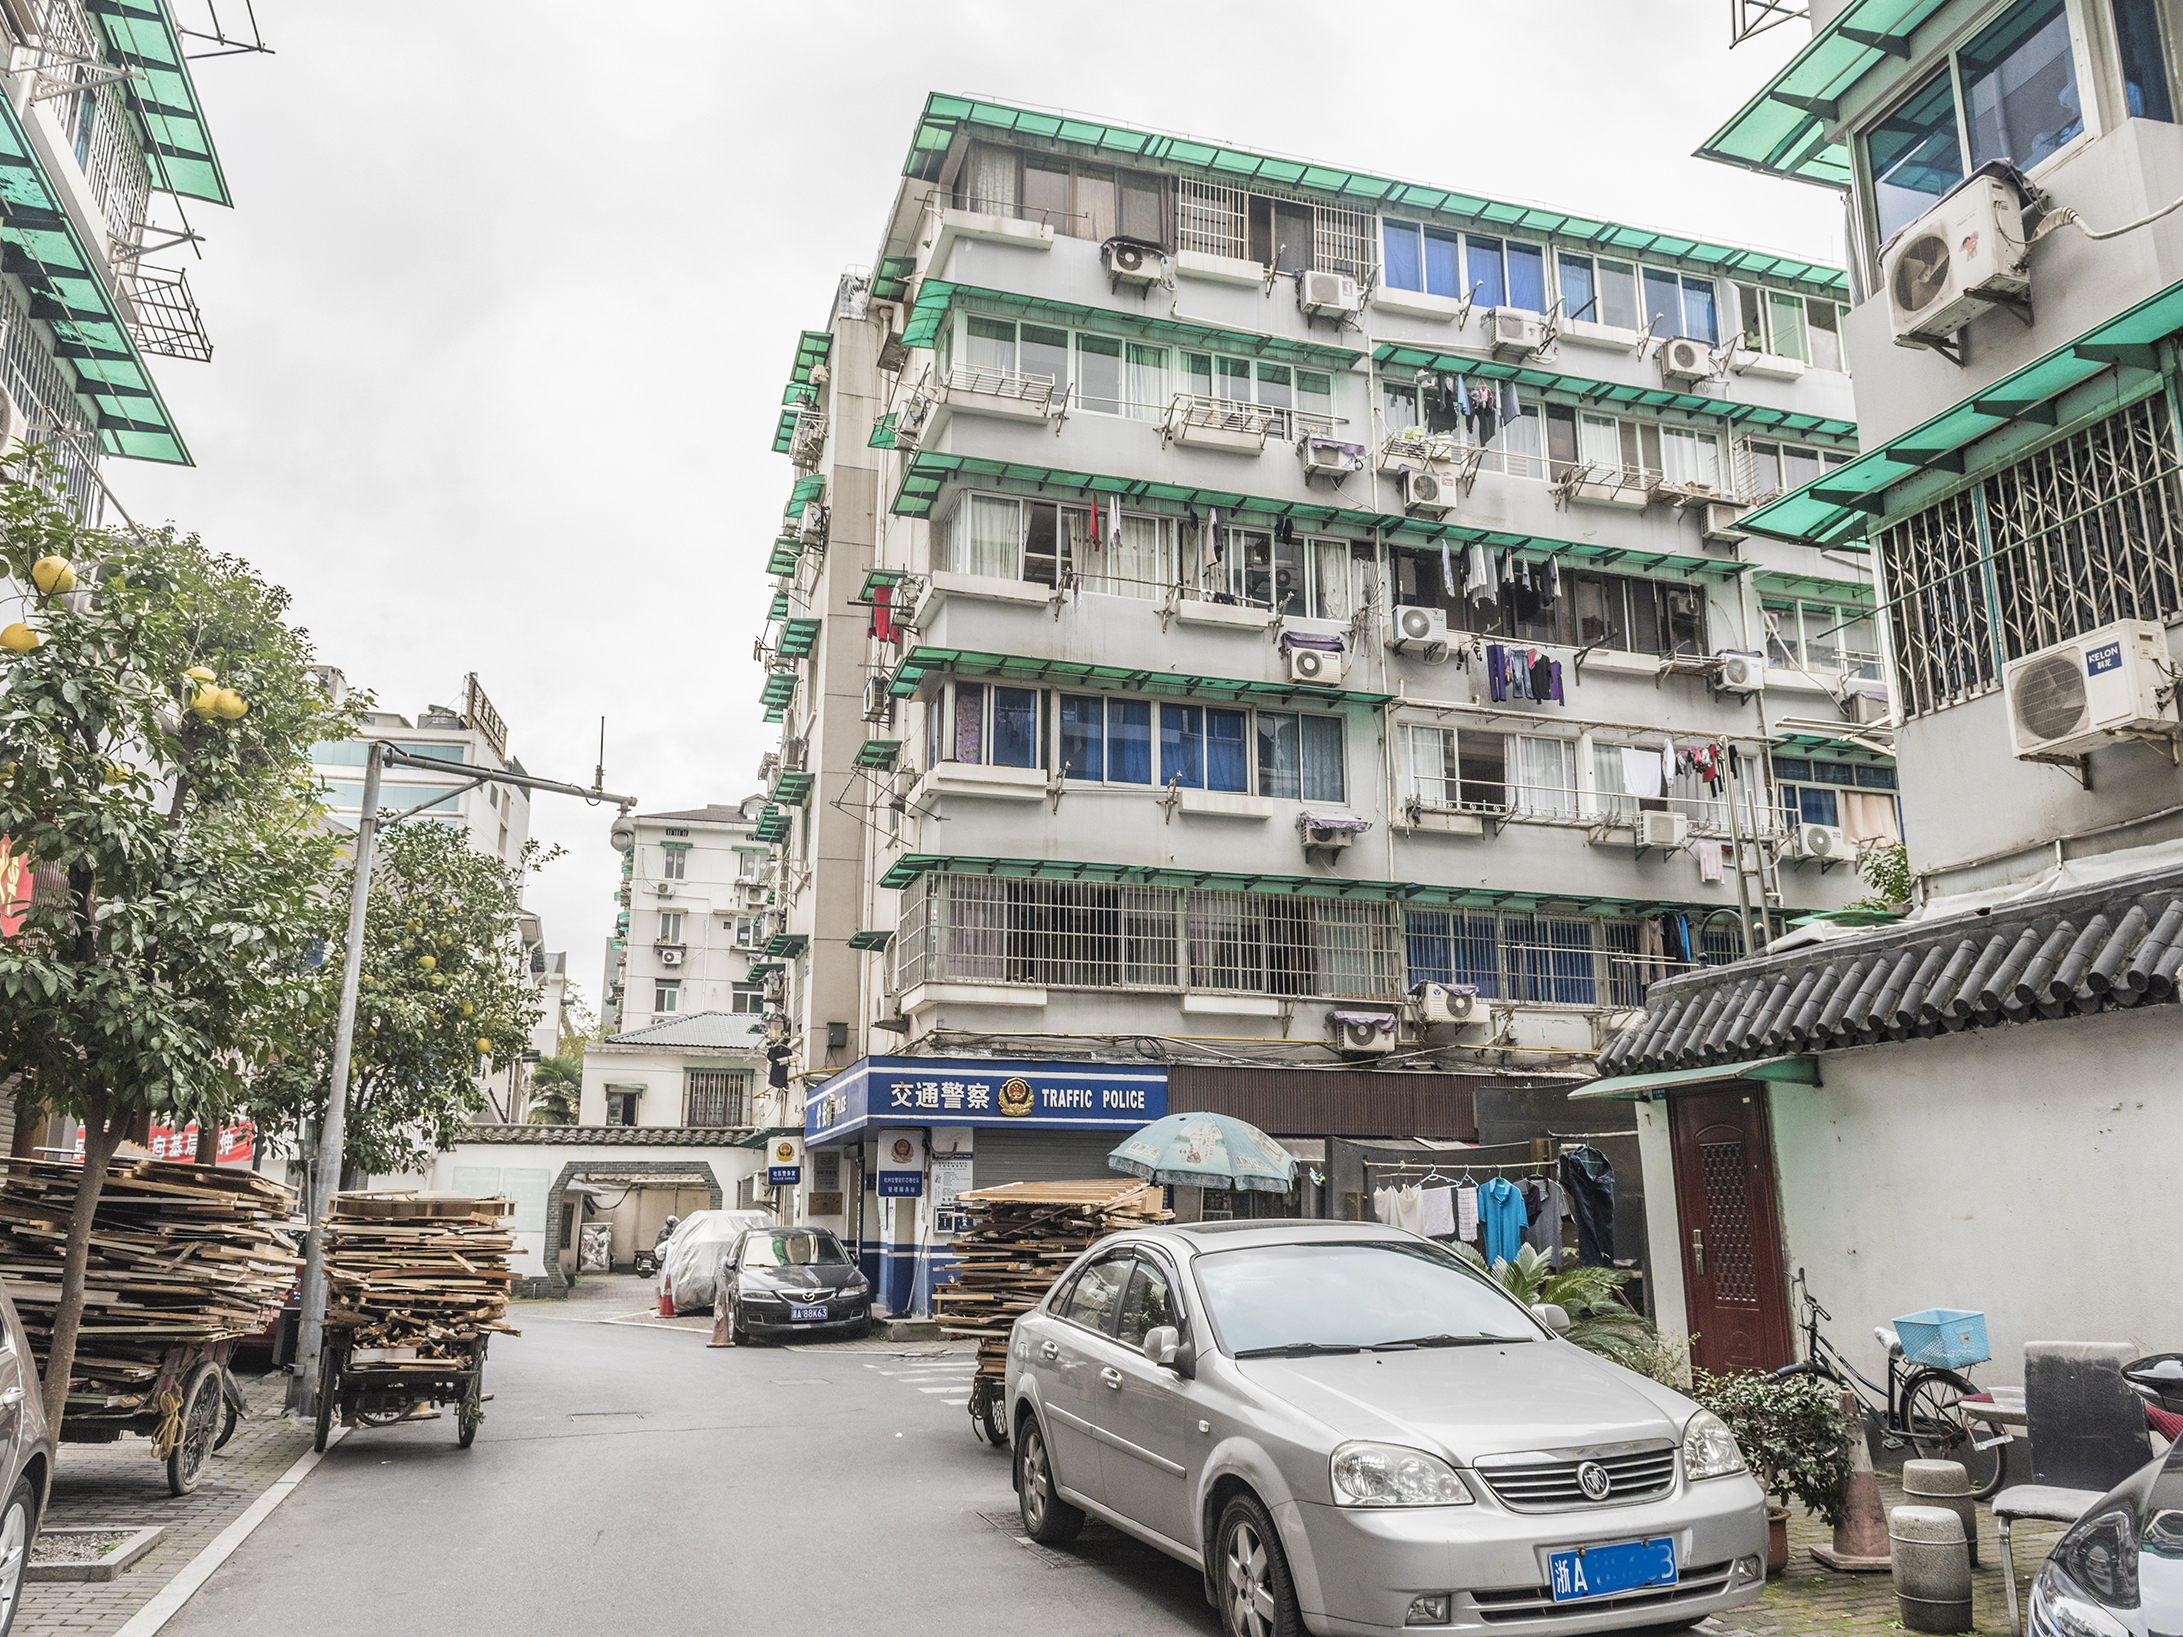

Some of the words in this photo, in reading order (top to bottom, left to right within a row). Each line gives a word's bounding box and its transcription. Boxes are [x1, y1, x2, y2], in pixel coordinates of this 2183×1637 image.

[2088, 646, 2119, 663] KELON
[890, 1081, 990, 1109] 交通警察
[1042, 1088, 1092, 1109] TRAFFIC
[1103, 1089, 1145, 1110] POLICE
